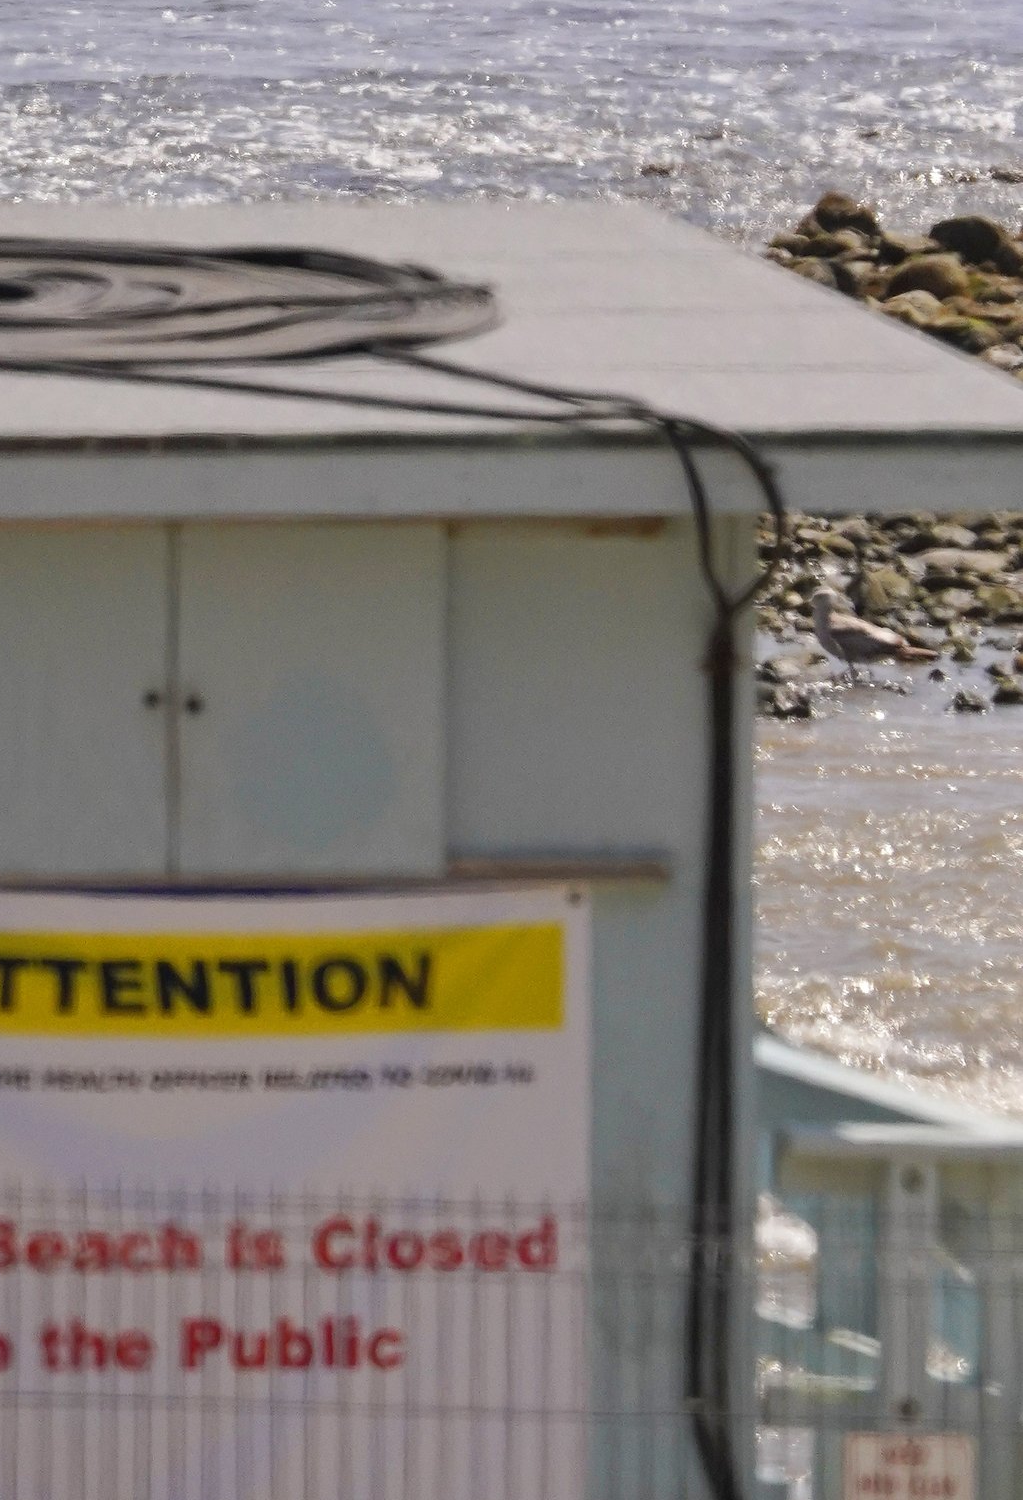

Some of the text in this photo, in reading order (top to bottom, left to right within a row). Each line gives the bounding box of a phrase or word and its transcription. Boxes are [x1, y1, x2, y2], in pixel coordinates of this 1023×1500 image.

[225, 1224, 286, 1273] is
[311, 1215, 558, 1275] Closed
[38, 1319, 154, 1373] the
[179, 1315, 406, 1373] Public
